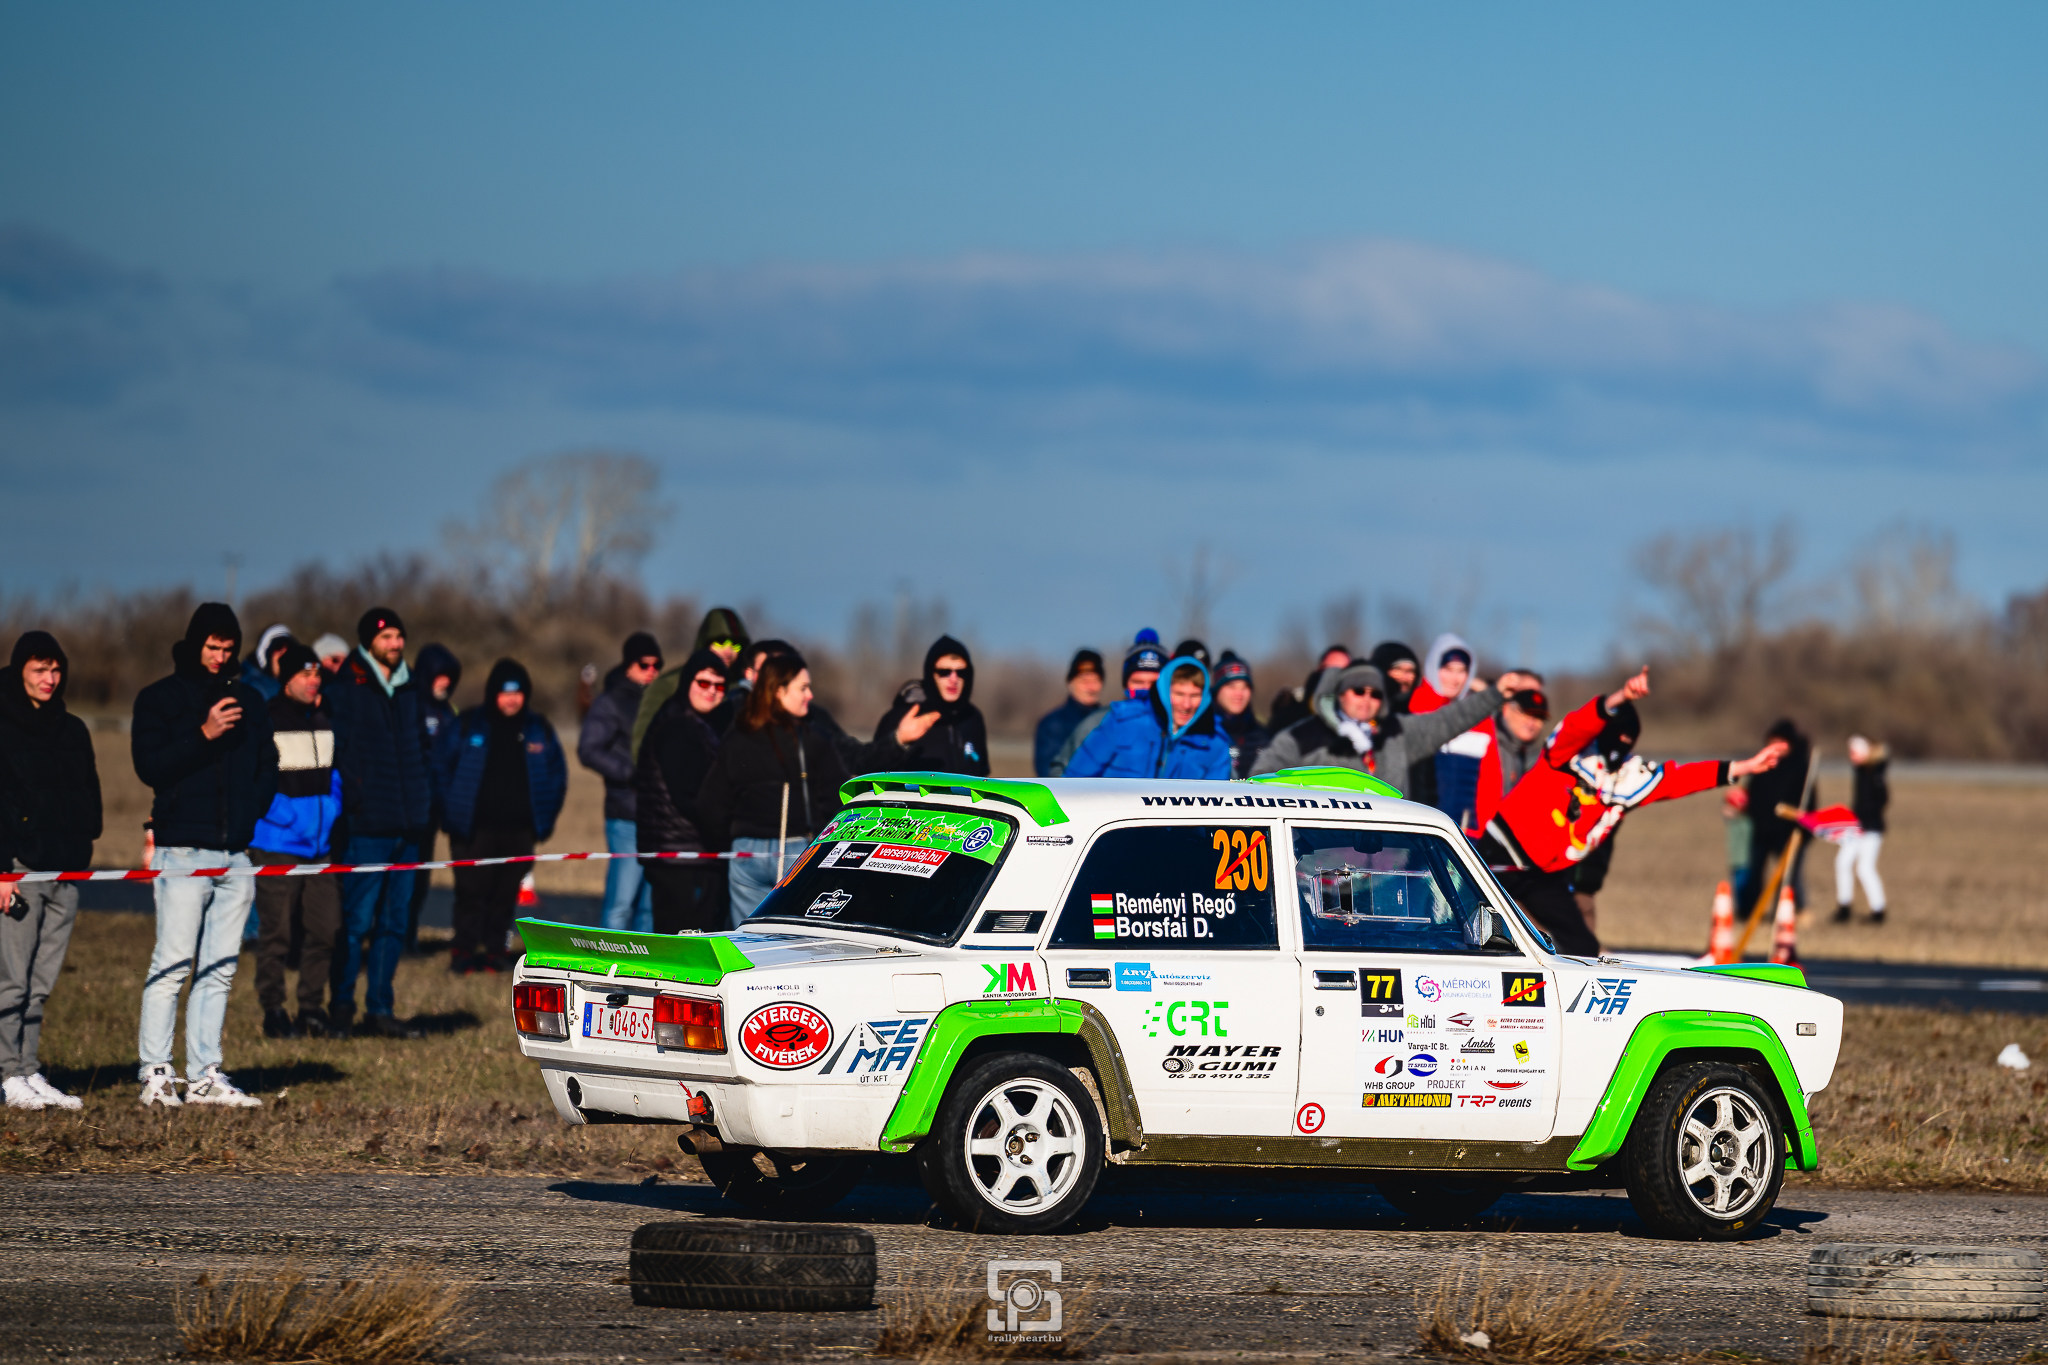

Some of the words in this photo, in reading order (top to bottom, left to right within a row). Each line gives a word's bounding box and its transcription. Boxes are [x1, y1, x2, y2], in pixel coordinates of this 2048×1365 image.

[1141, 796, 1372, 810] www.duen.hu
[879, 846, 942, 862] versenyolaj.hu
[1213, 829, 1269, 892] 230
[1116, 893, 1186, 919] Reményi
[1192, 893, 1235, 918] Regő
[1117, 916, 1187, 938] Borsfai
[1193, 918, 1213, 938] D.
[570, 937, 650, 955] www.duen.hu
[1367, 975, 1395, 999] 77
[1442, 977, 1491, 989] MÉRNÖKI
[1509, 978, 1538, 1002] 45
[584, 1022, 590, 1031] H
[747, 1007, 826, 1035] NYERGESI
[1407, 1042, 1438, 1051] Varga-IC
[1440, 1043, 1450, 1051] Bt.
[1461, 1036, 1495, 1048] Amtek
[754, 1041, 819, 1064] FIVÉREK
[1166, 1045, 1282, 1057] MAYER
[1198, 1061, 1277, 1071] GUMI
[860, 1075, 870, 1084] ÚT
[873, 1074, 888, 1082] KFT
[1427, 1080, 1466, 1089] PROJEKT
[1364, 1082, 1383, 1090] WHB
[1385, 1082, 1415, 1090] GROUP
[1377, 1094, 1451, 1107] METABOND
[1457, 1095, 1497, 1108] TRP
[1498, 1098, 1532, 1108] events
[1305, 1110, 1316, 1127] E
